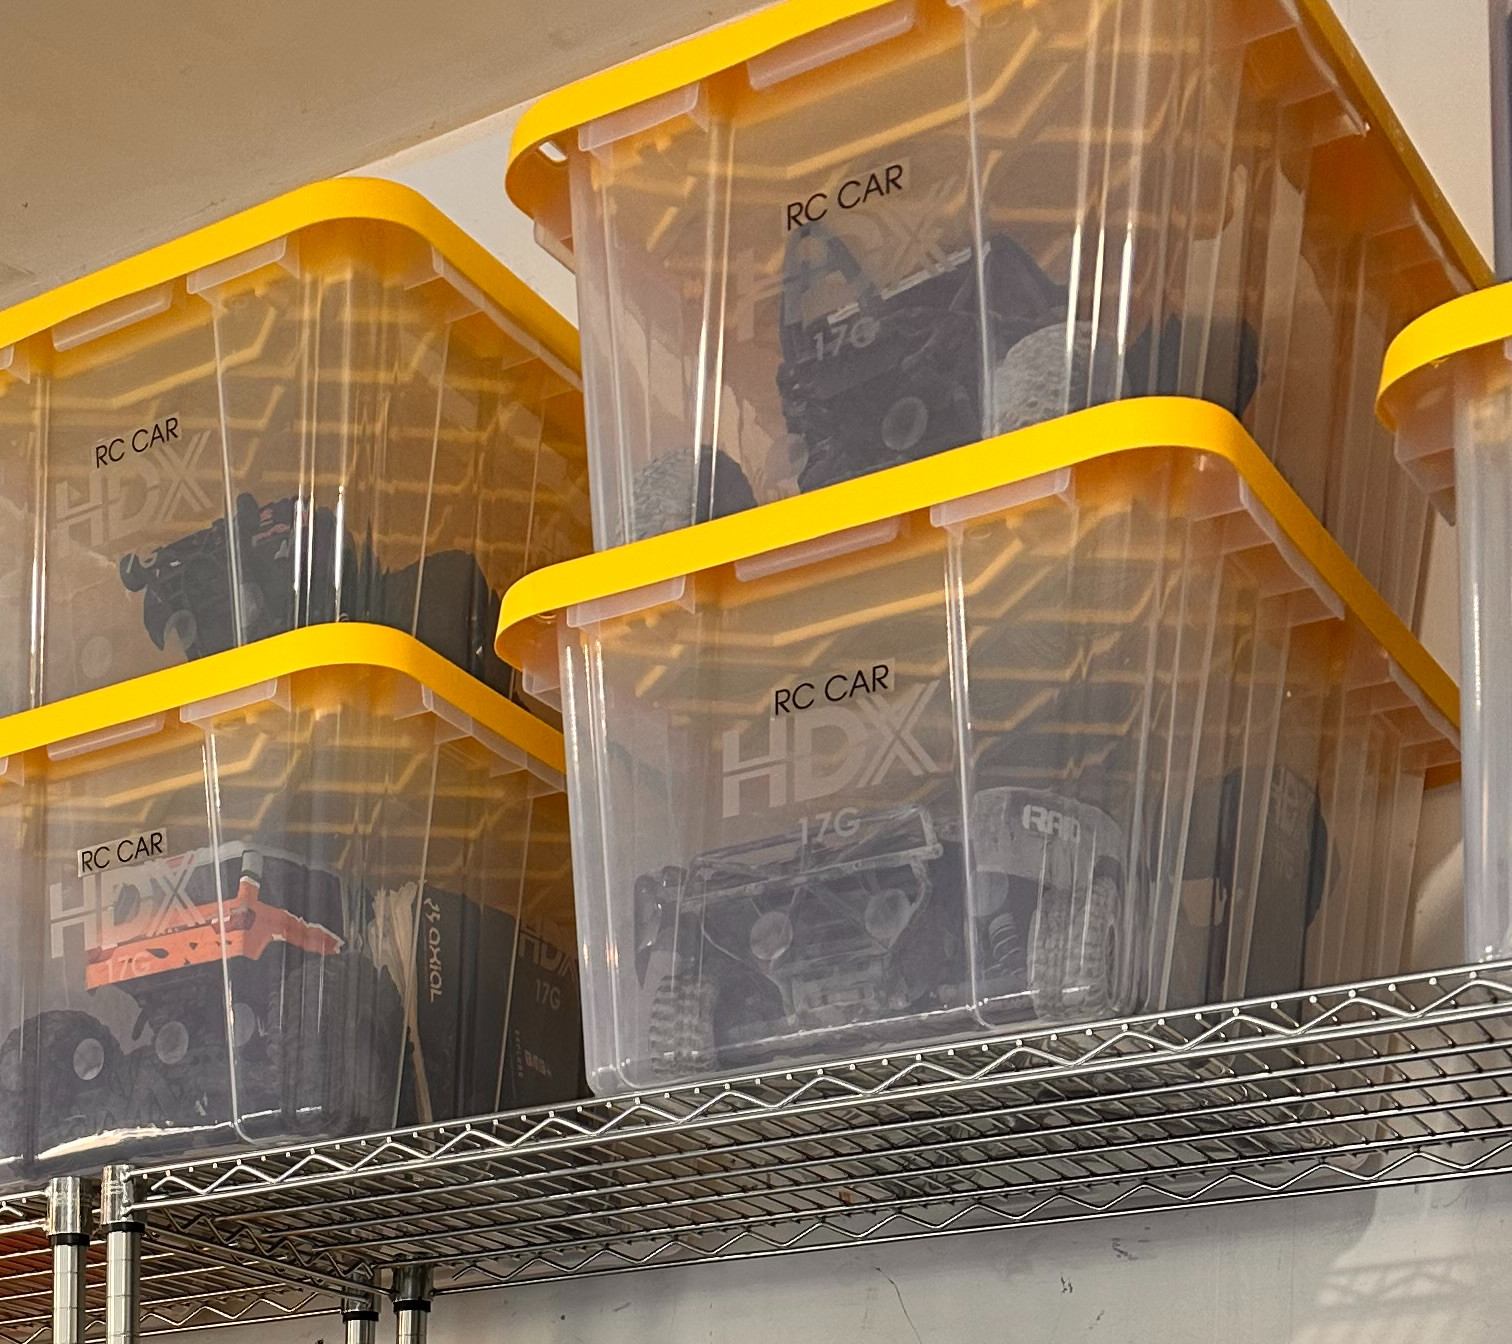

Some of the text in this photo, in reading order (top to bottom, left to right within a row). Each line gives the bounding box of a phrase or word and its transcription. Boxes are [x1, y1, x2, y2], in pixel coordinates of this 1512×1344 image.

[786, 164, 906, 231] RC CAR
[94, 417, 180, 469] RC CAR
[54, 428, 213, 549] HDX
[772, 663, 890, 717] RC CAR
[720, 681, 942, 818] HDX
[81, 831, 164, 873] RC CAR
[797, 808, 862, 847] 17G
[49, 851, 206, 959] HDX
[104, 950, 153, 984] 17G
